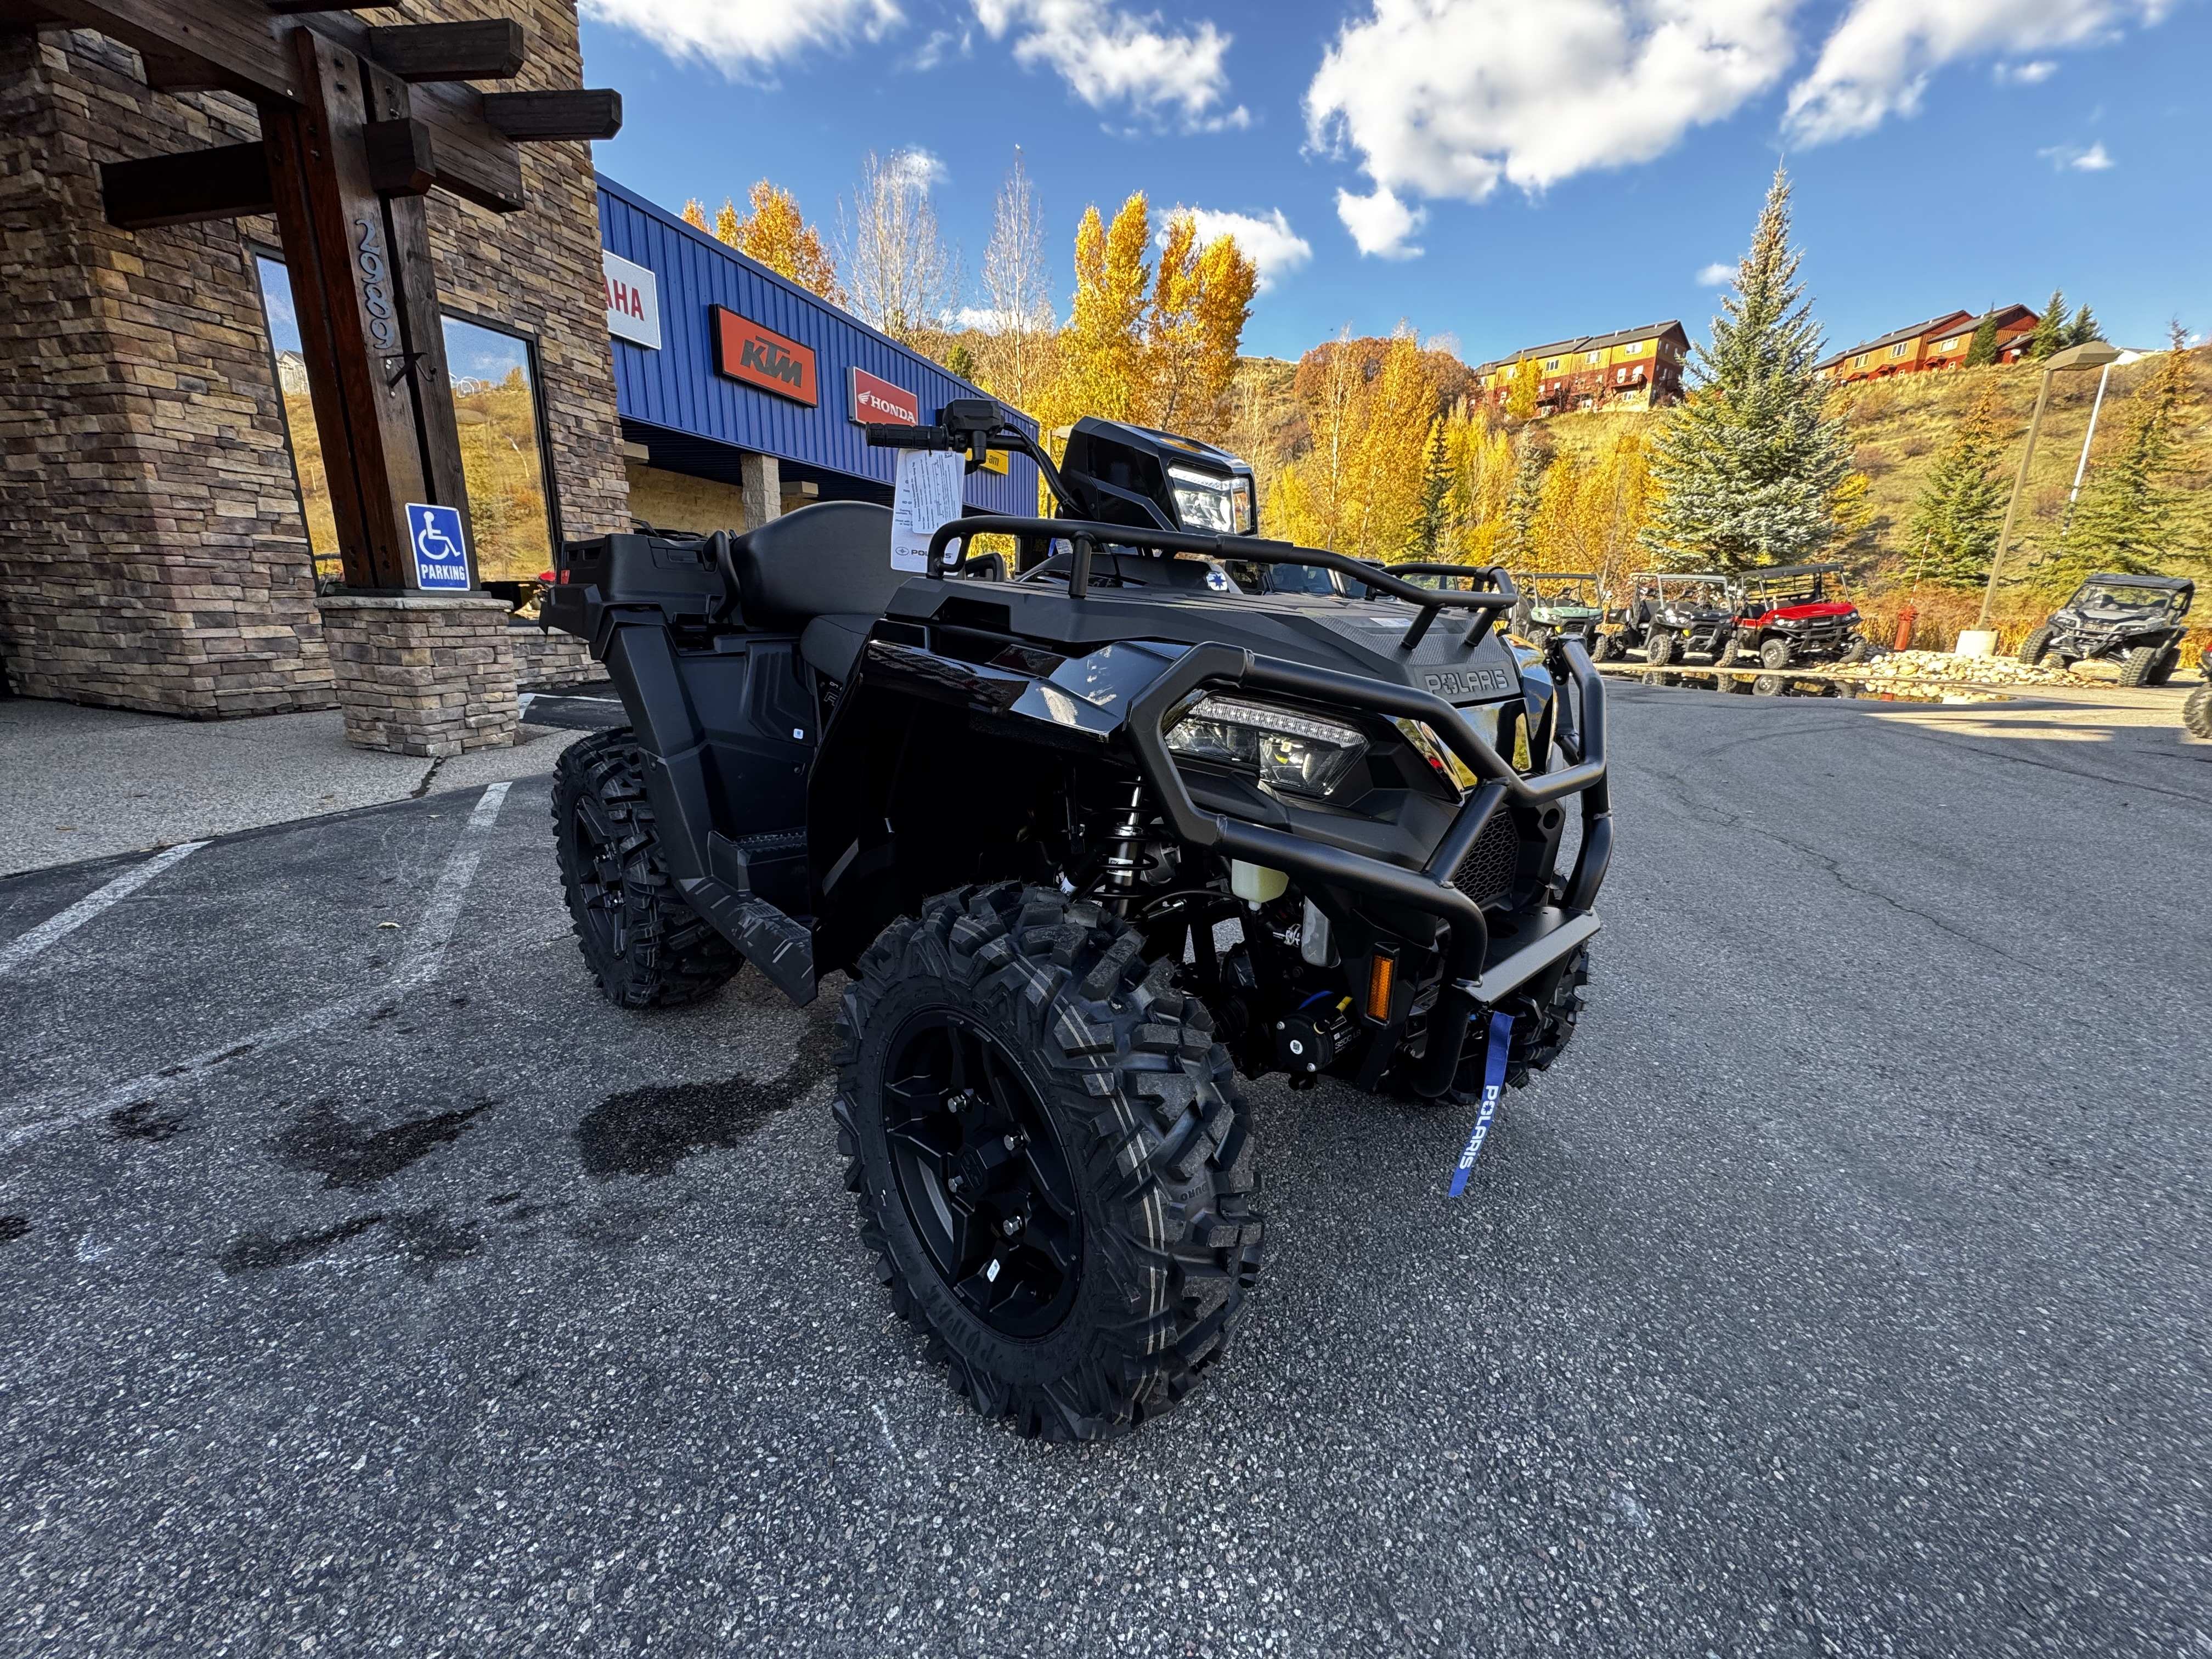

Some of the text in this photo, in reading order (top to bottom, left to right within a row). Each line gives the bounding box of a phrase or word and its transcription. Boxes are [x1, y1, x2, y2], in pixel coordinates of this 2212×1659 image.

[355, 219, 396, 349] 2989
[740, 335, 803, 388] KTM
[870, 394, 917, 424] HONDA
[911, 549, 952, 559] POLS
[421, 564, 466, 580] PARKING
[1425, 669, 1509, 695] POLARIS
[1459, 1085, 1499, 1170] POLARIS
